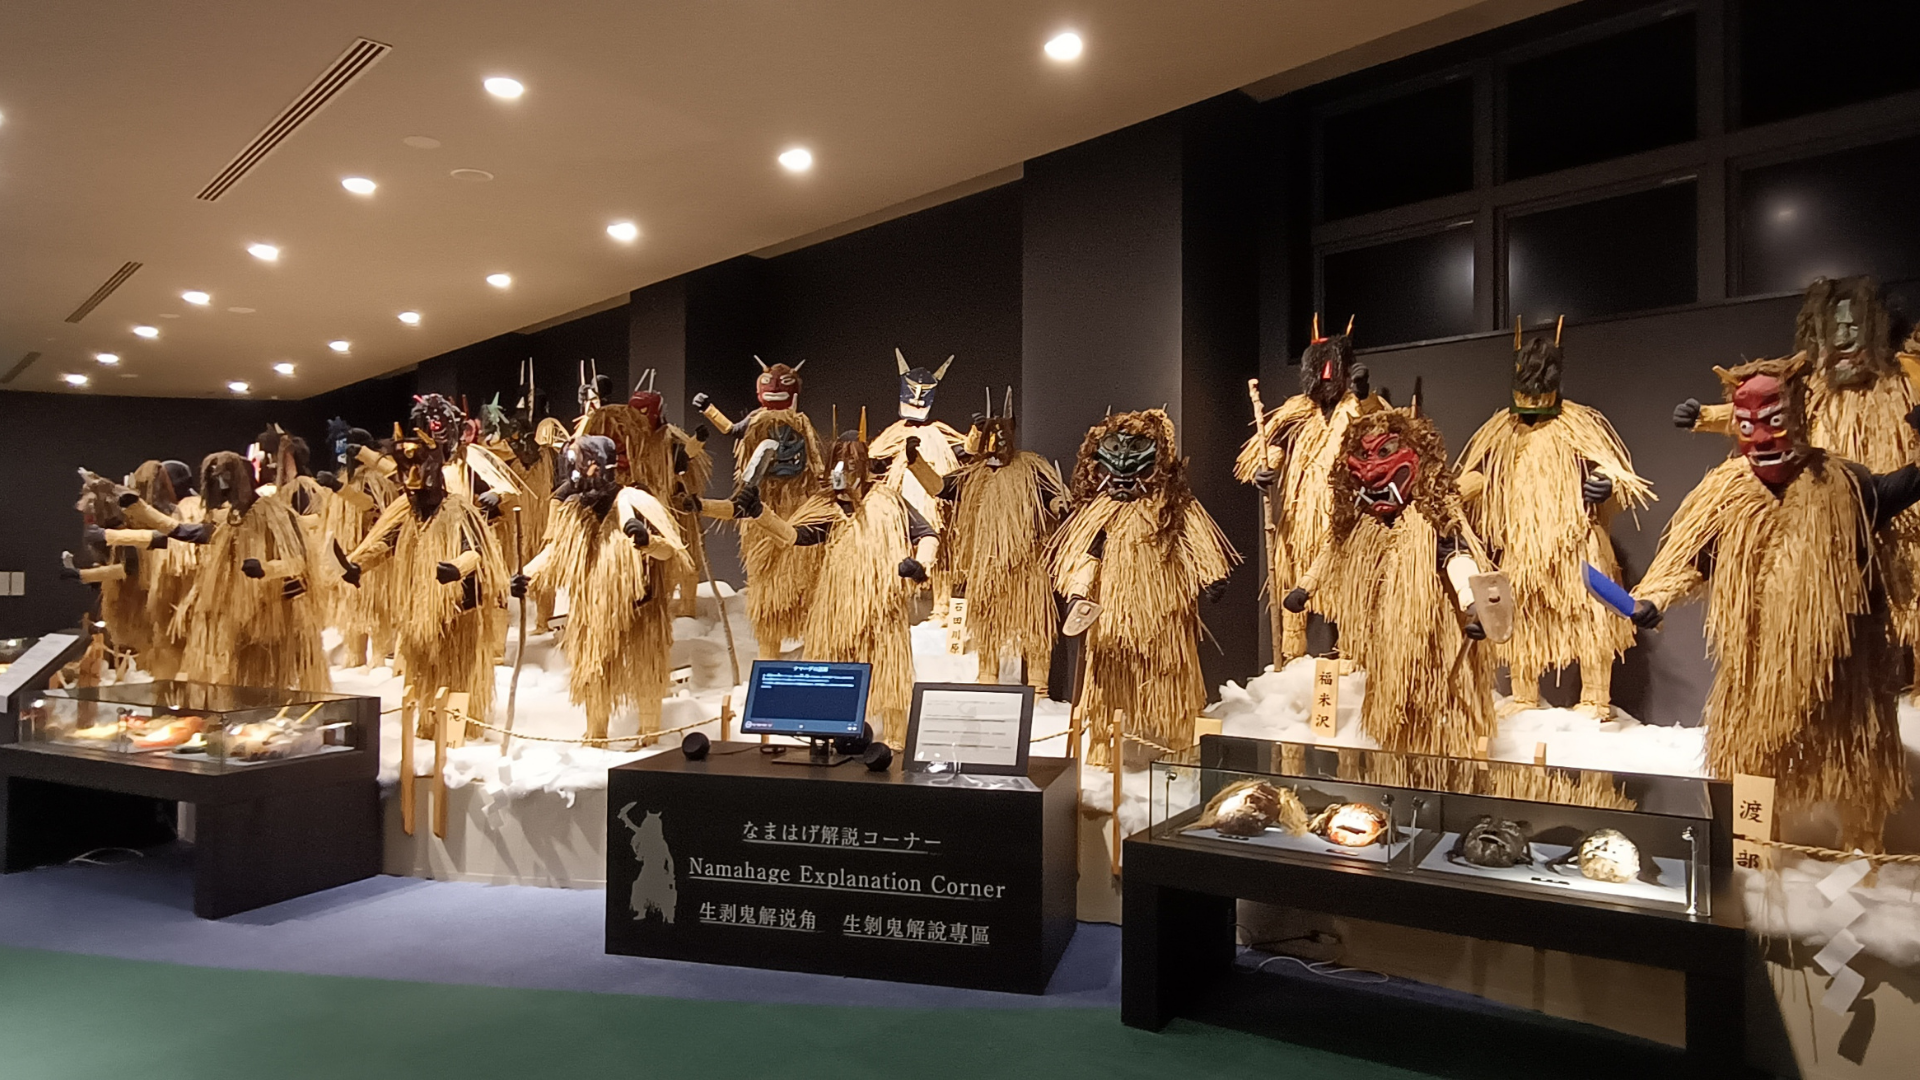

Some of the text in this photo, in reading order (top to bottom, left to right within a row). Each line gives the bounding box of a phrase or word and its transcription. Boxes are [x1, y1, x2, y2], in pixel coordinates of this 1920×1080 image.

[1315, 671, 1333, 728] 福米沢
[742, 820, 942, 850] なまはげ解説コーナー
[1735, 799, 1763, 869] 渡部
[688, 856, 1006, 899] Namahage Explanation Corner
[699, 901, 817, 930] 生剥鬼解说角
